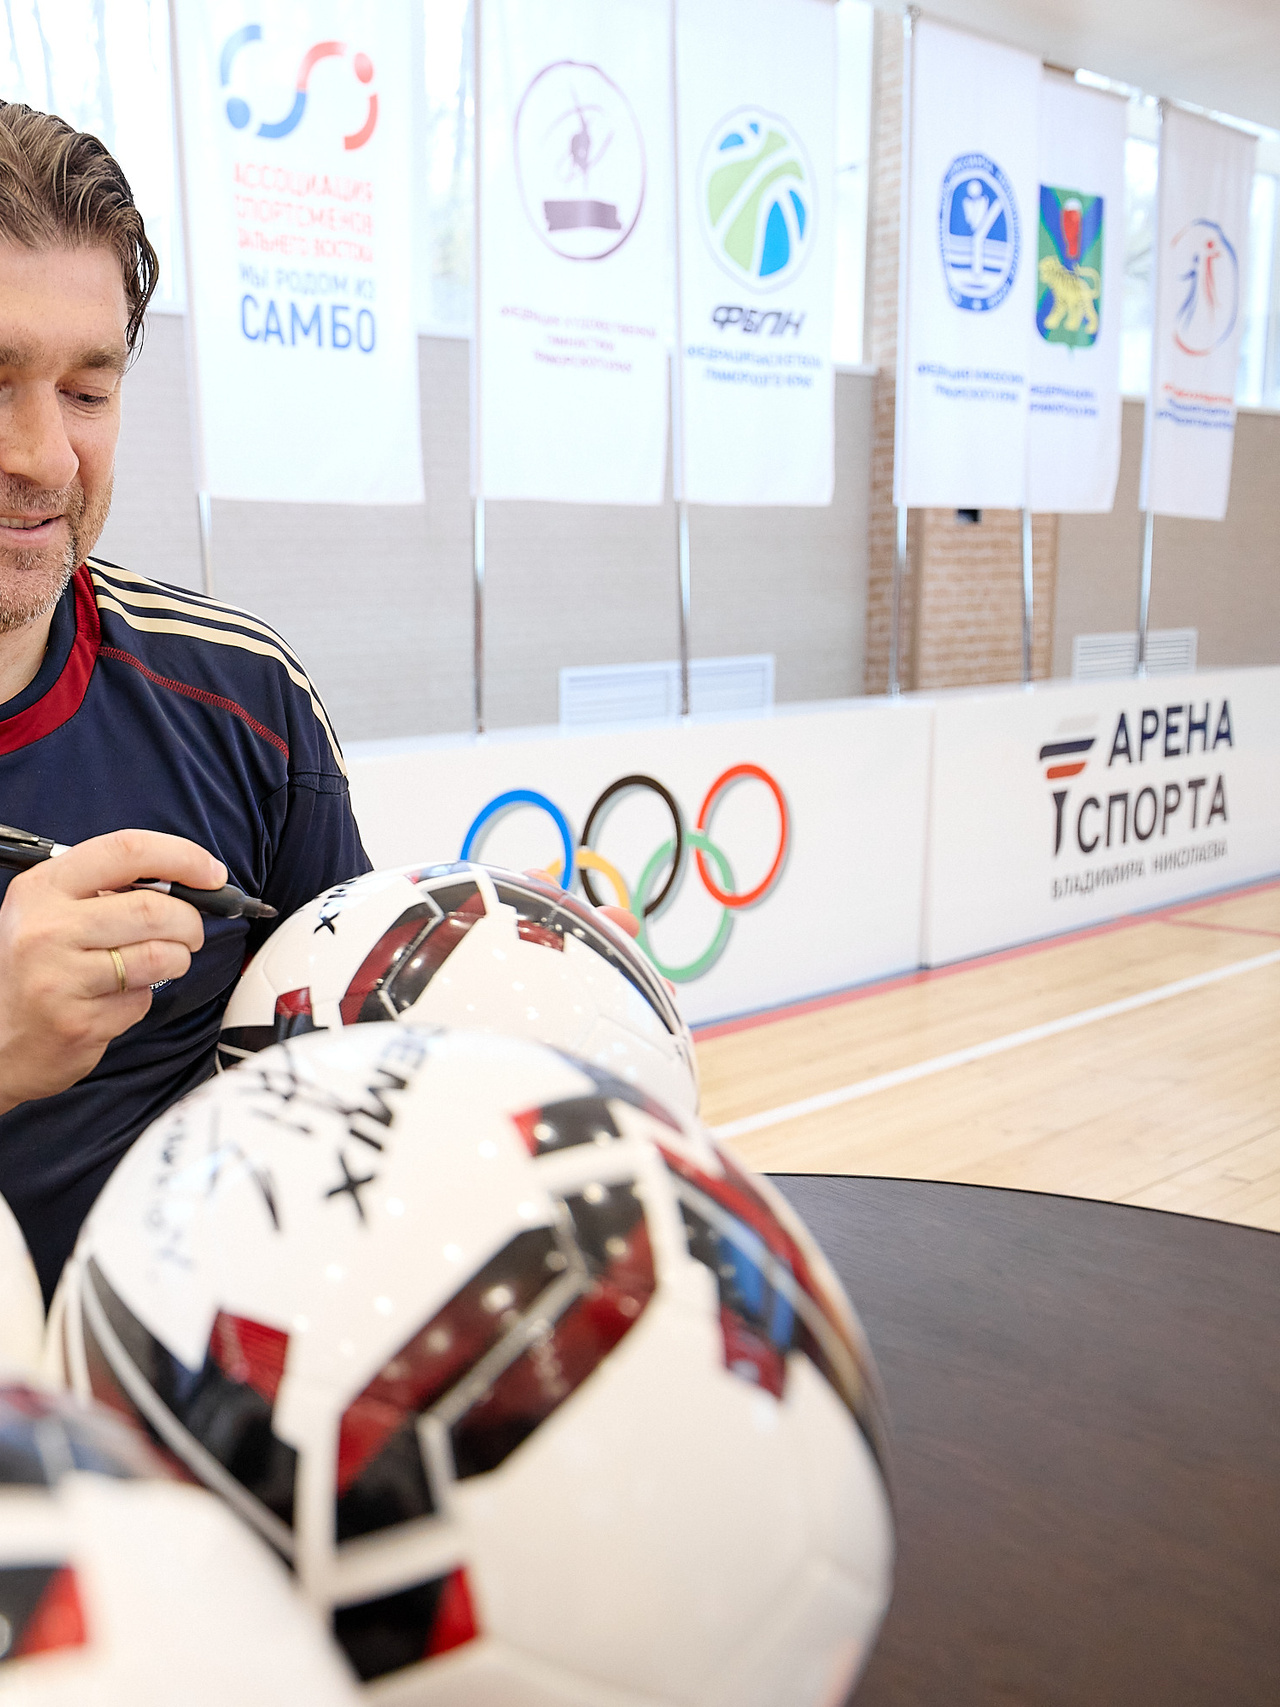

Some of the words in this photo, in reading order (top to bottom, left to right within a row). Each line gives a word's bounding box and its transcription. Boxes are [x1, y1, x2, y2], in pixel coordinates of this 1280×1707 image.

[241, 294, 375, 353] САМБО
[1107, 700, 1233, 767] АРЕНА
[1077, 775, 1228, 853] СПОРТА
